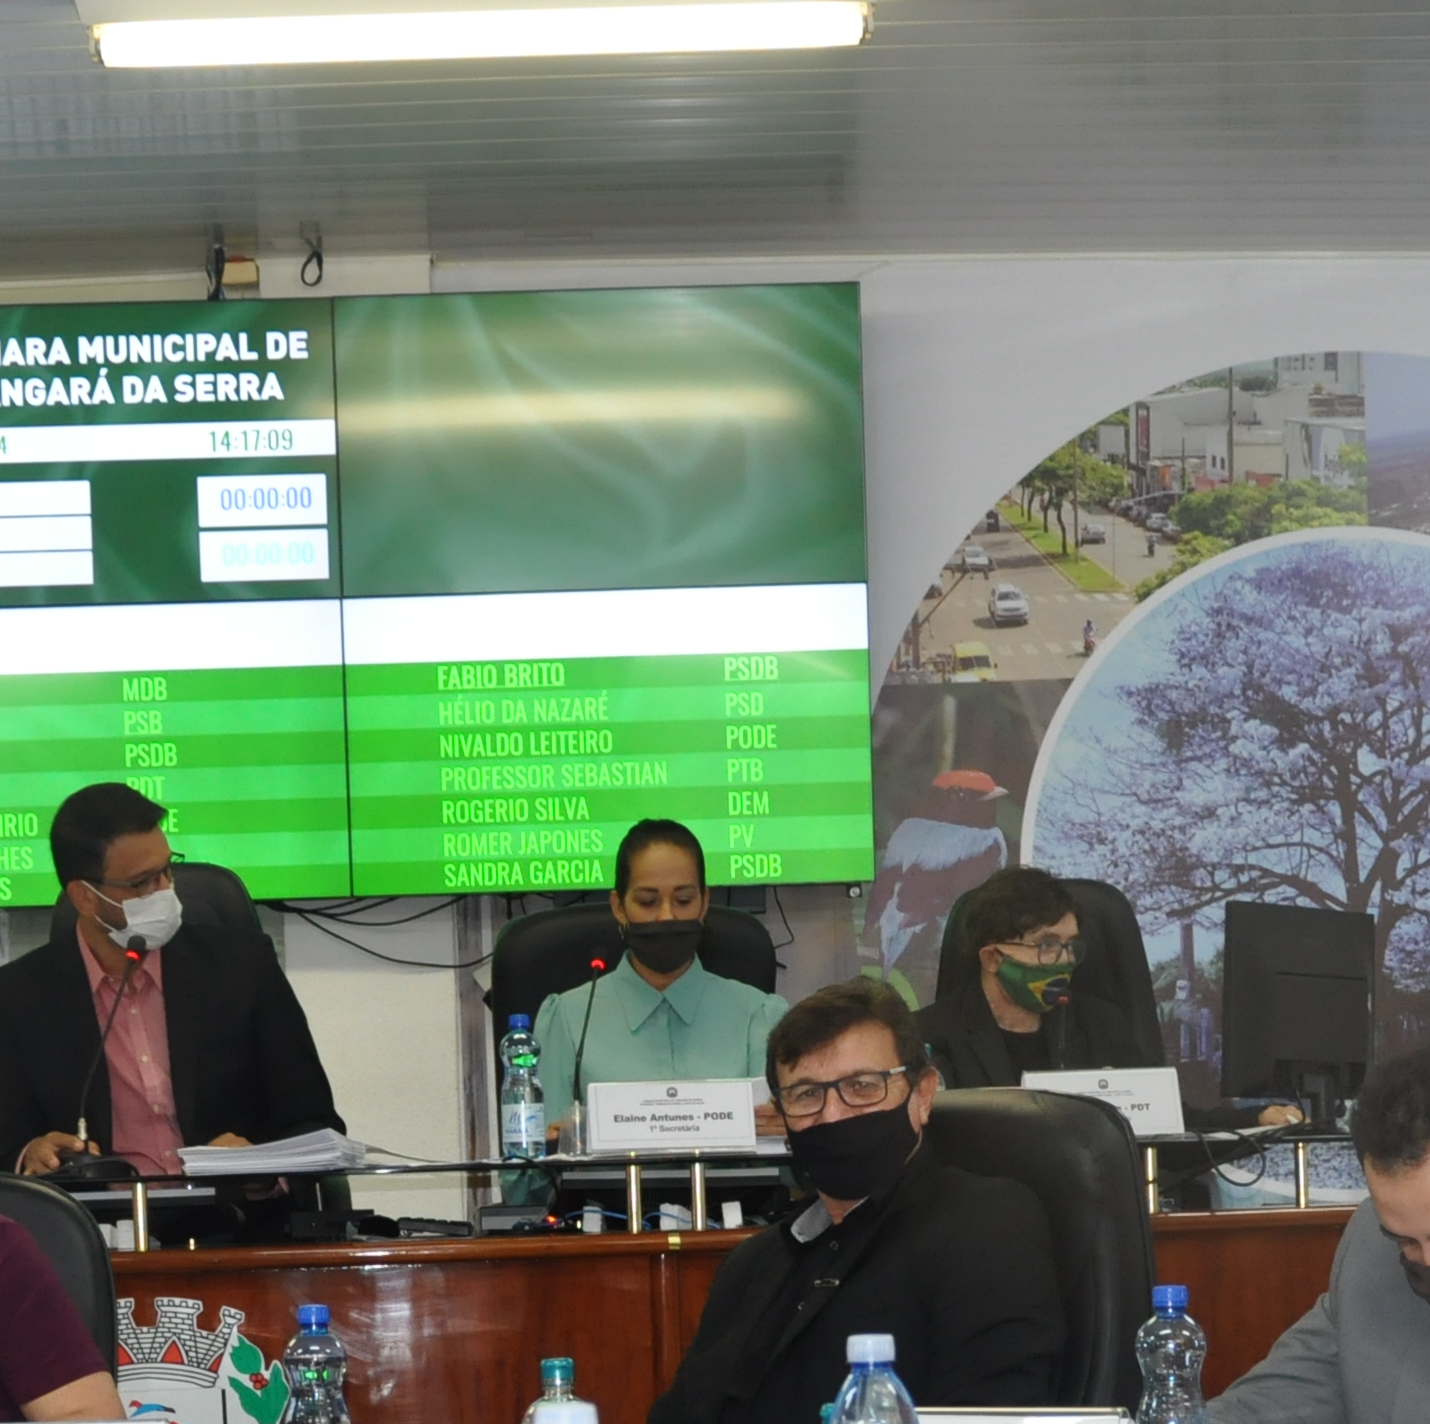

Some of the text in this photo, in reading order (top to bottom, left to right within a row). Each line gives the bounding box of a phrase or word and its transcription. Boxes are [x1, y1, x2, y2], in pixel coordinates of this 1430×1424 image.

[78, 333, 259, 364] MUNICIPAL
[266, 331, 309, 360] DE
[122, 375, 168, 404] DA
[174, 372, 285, 403] SERRA
[208, 429, 294, 452] 14:17:09
[220, 486, 313, 511] 00:00:00
[438, 662, 566, 690] FABIO BRITO
[724, 656, 779, 681] PSDB
[122, 676, 168, 702] MDB
[439, 690, 609, 725] HÉLIO DA NAZARÉ
[725, 692, 764, 717] PSD
[123, 709, 163, 735] PSB
[439, 730, 613, 758] NIVALDO LEITEIRO
[726, 724, 778, 749] PODE
[125, 742, 178, 768] PSDB
[441, 761, 668, 791] PROFESSOR SEBASTIAN
[727, 757, 764, 783] PTB
[127, 775, 165, 800] PDT
[442, 796, 590, 824] ROGERIO SILVA
[728, 791, 770, 816] DEM
[444, 829, 603, 858] ROMER JAPONES
[729, 824, 755, 849] PV
[444, 859, 604, 888] SANDRA GARCIA
[730, 854, 782, 879] PSDB
[614, 1114, 647, 1123] Elaine
[650, 1112, 694, 1123] Antunes
[703, 1112, 734, 1121] PODE
[1130, 1103, 1150, 1111] PDT
